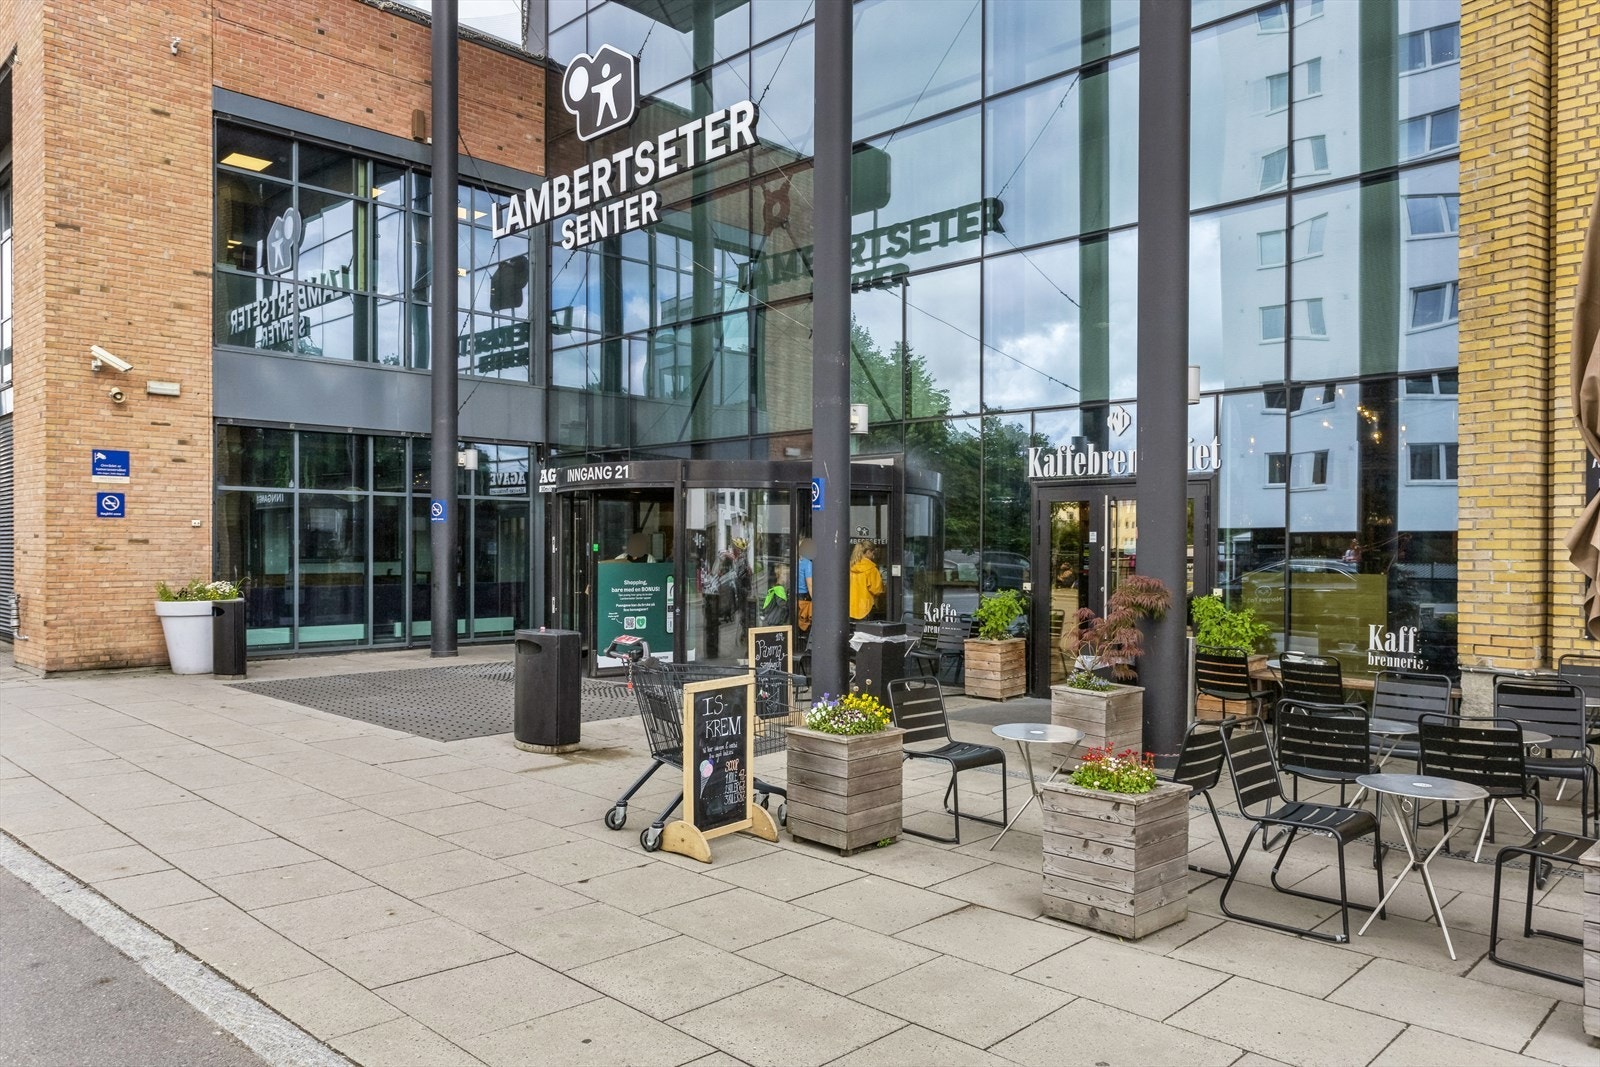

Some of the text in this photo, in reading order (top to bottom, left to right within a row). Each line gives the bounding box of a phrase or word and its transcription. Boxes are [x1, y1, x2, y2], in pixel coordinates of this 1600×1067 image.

[491, 99, 756, 239] LAMBERTSETER
[561, 190, 658, 250] SENTER
[567, 465, 629, 482] INNGANG 21
[1367, 624, 1419, 653] Kaff
[702, 694, 729, 717] IS-
[705, 715, 742, 739] KREM
